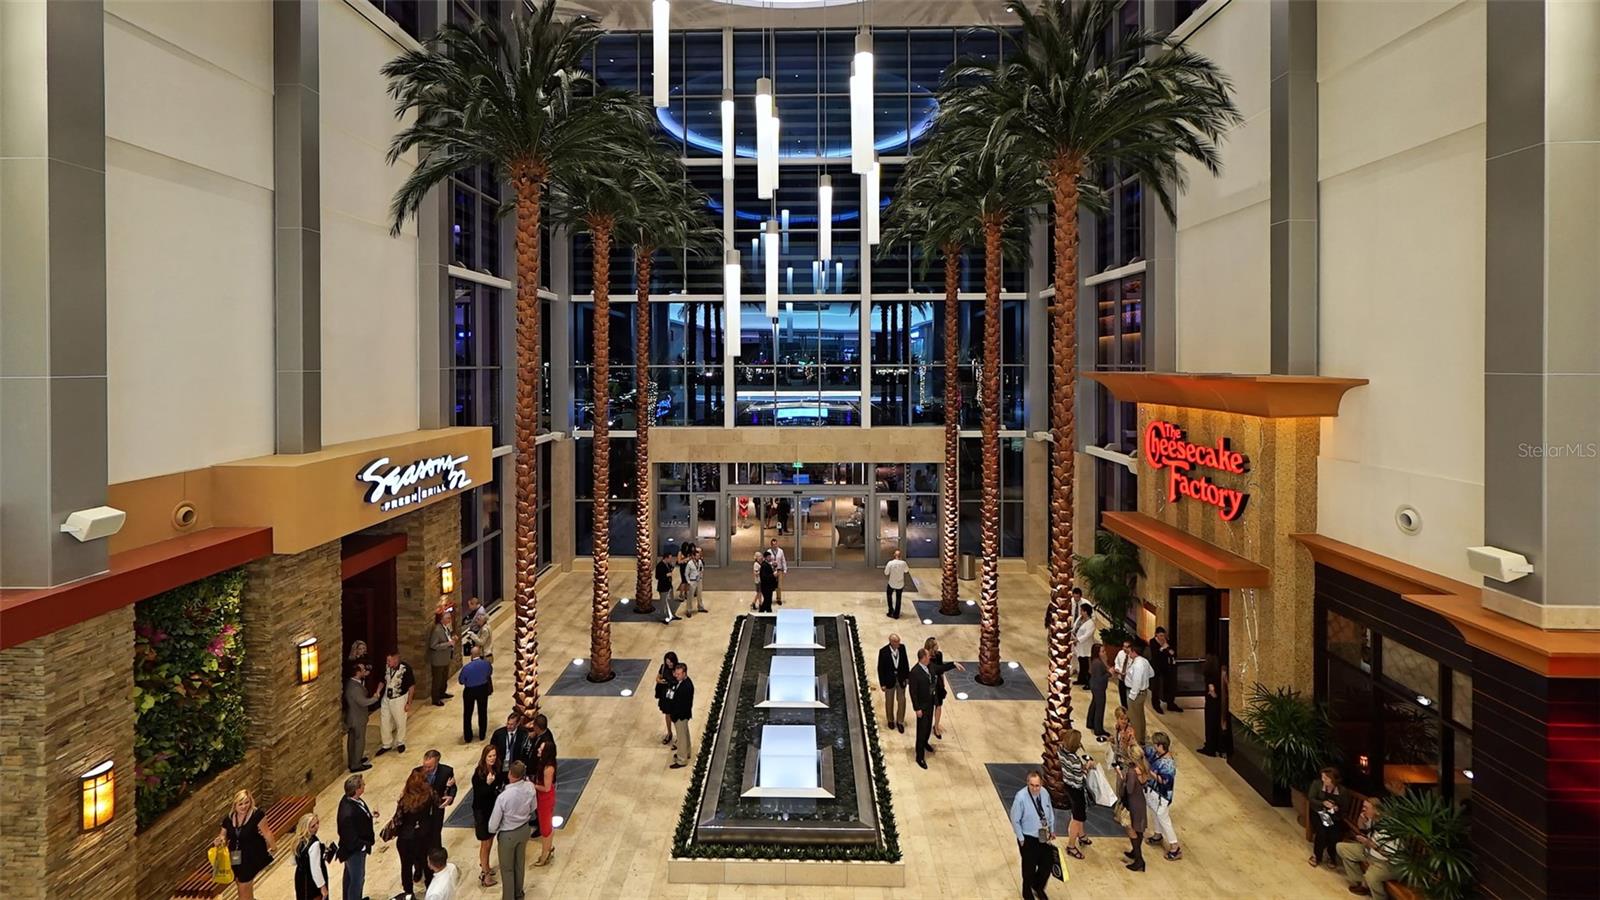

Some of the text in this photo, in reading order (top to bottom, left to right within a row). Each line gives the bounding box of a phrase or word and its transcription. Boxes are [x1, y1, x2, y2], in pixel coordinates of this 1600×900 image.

[1145, 420, 1244, 474] Cheesecake
[1164, 423, 1182, 440] The
[361, 455, 468, 503] Seasons
[421, 484, 447, 499] GRILL
[1162, 456, 1243, 521] Factory
